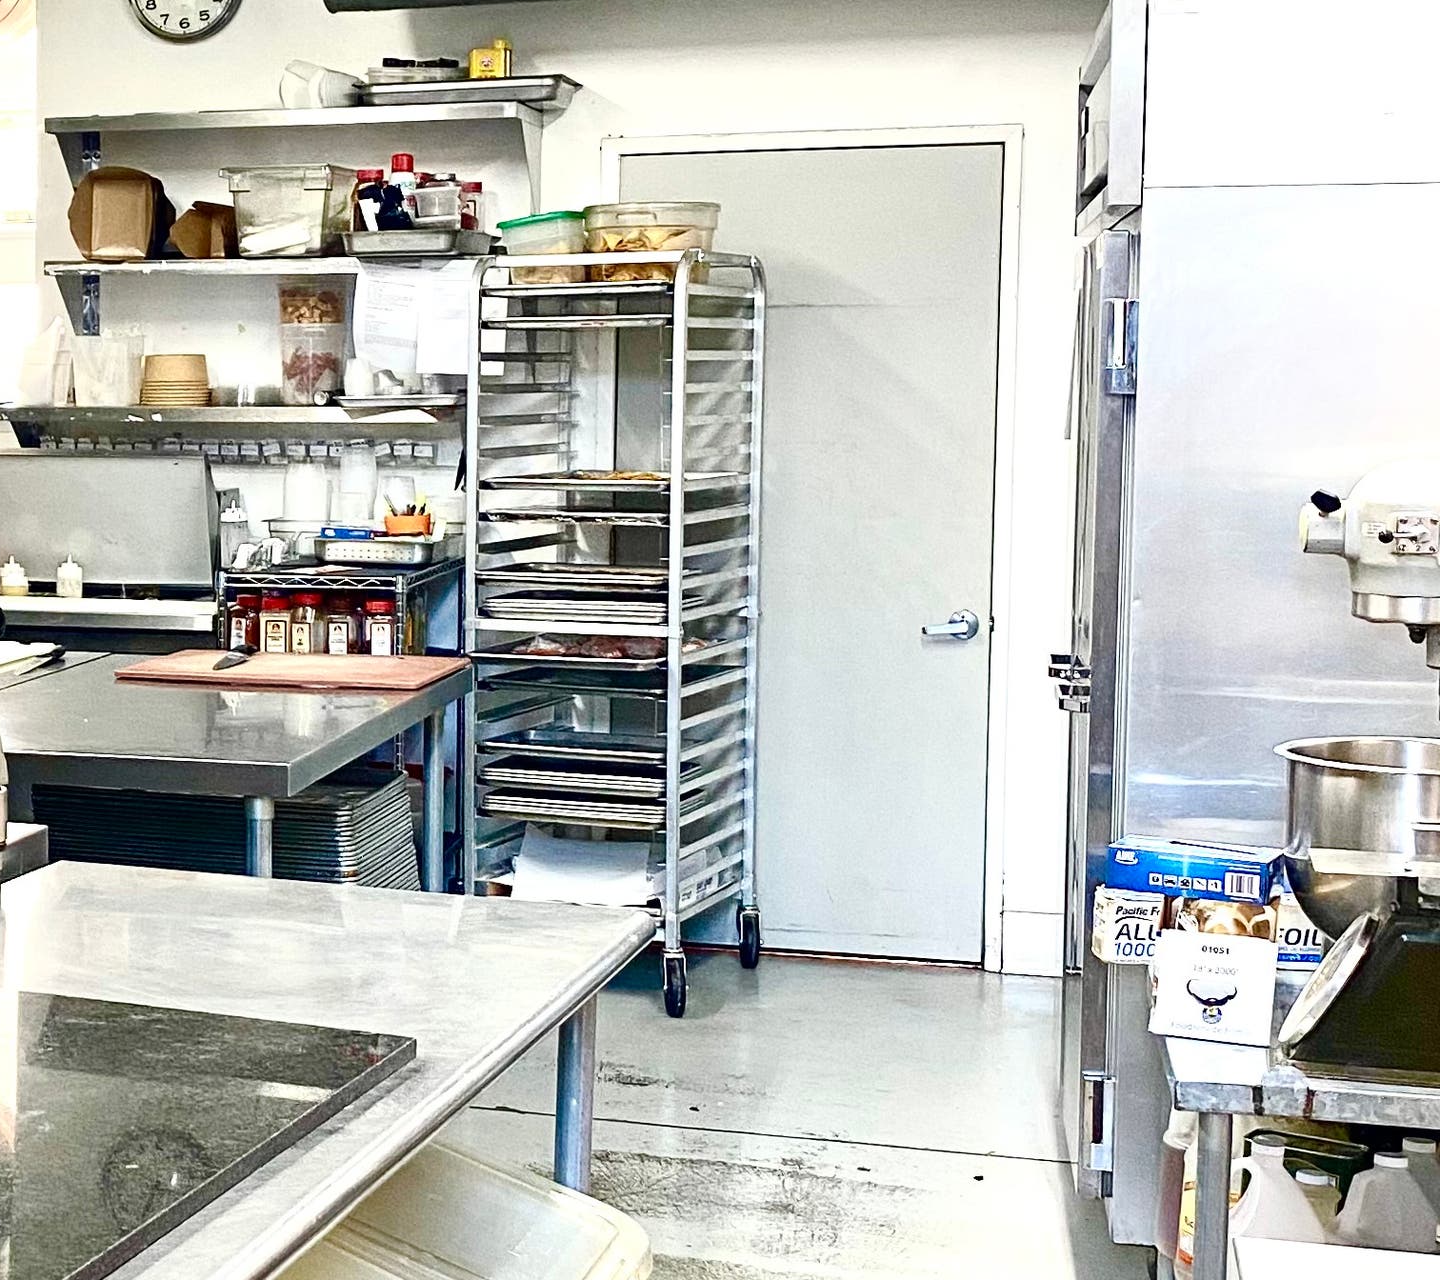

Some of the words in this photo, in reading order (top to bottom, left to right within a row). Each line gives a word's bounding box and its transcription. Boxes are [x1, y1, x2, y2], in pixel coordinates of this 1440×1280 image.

[145, 0, 157, 10] 8
[160, 13, 169, 25] 7
[199, 10, 210, 21] 5
[179, 17, 190, 29] 6
[1115, 906, 1148, 917] Pacific
